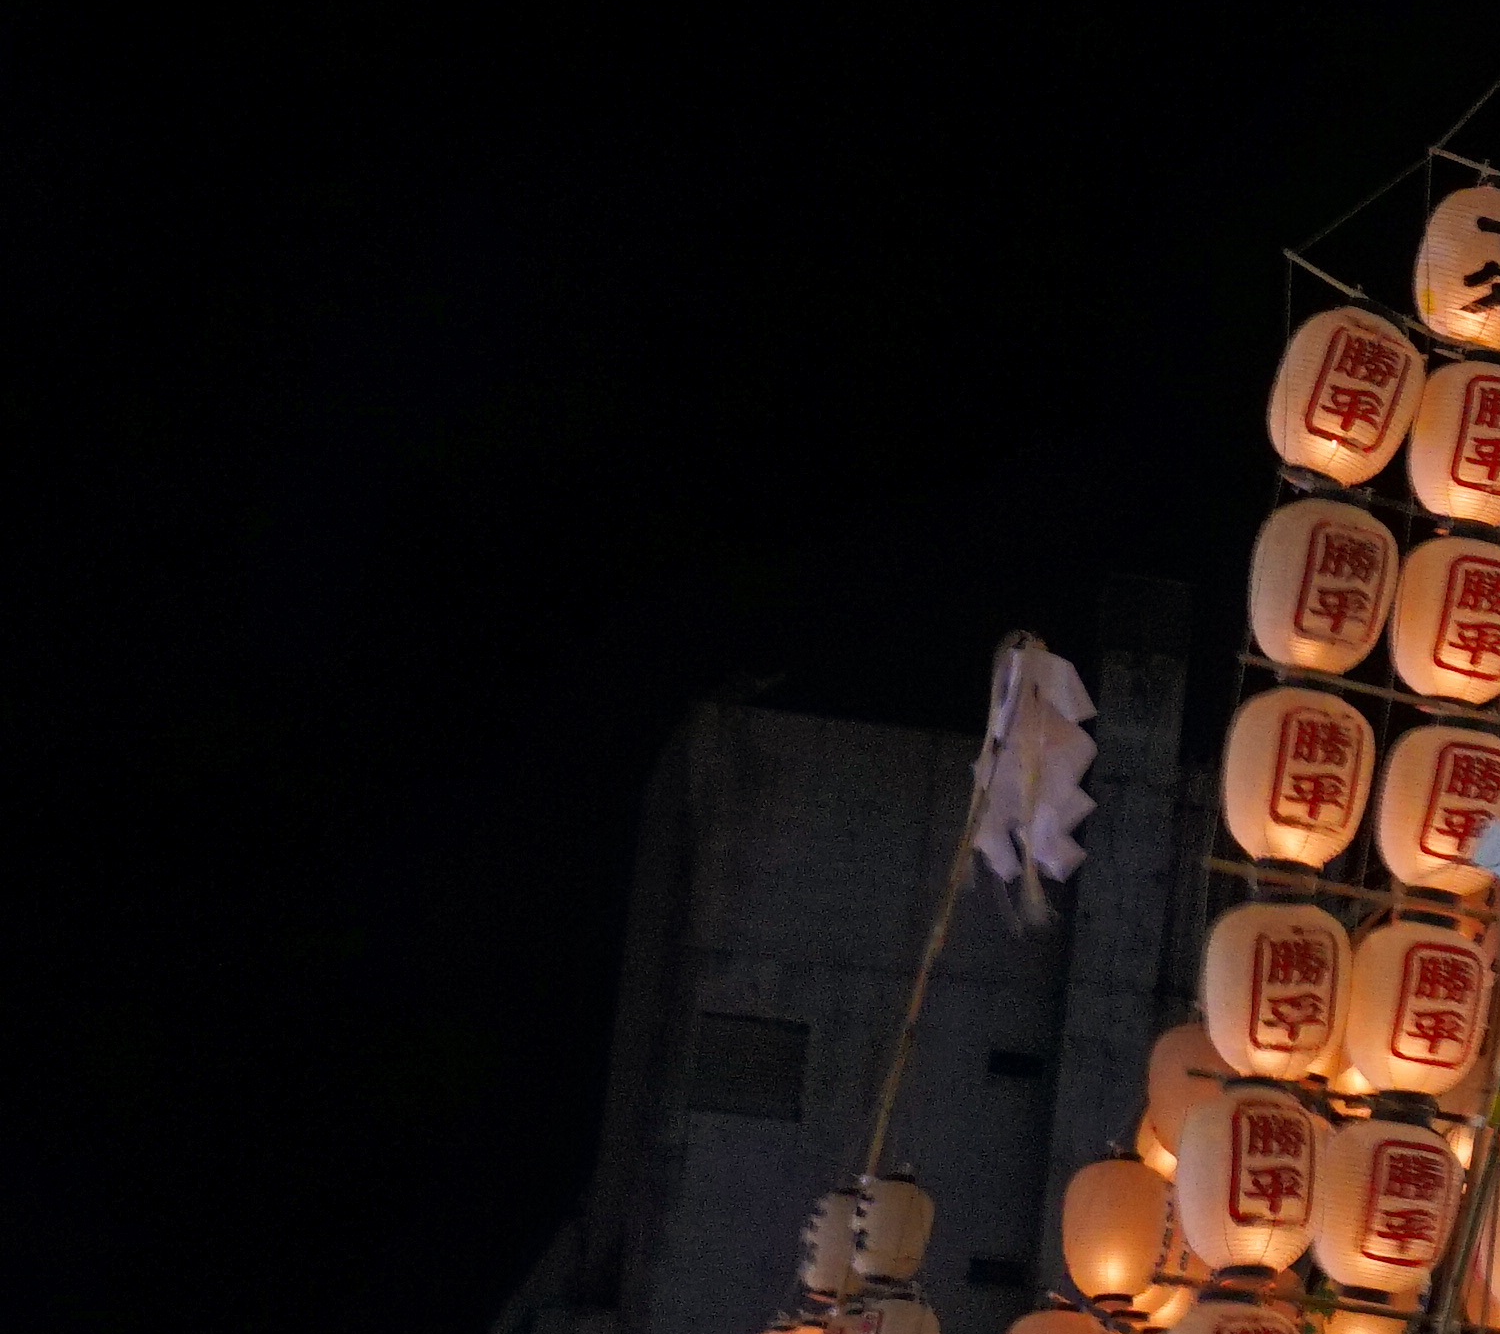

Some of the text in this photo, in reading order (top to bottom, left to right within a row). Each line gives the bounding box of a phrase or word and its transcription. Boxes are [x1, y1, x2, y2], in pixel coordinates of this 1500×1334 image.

[1323, 335, 1401, 431] 勝平
[1313, 536, 1381, 633] 勝平
[1288, 718, 1358, 820] 勝平
[1407, 966, 1474, 1053] 勝平
[1243, 1112, 1306, 1216] 勝平
[1374, 1152, 1448, 1257] 勝平
